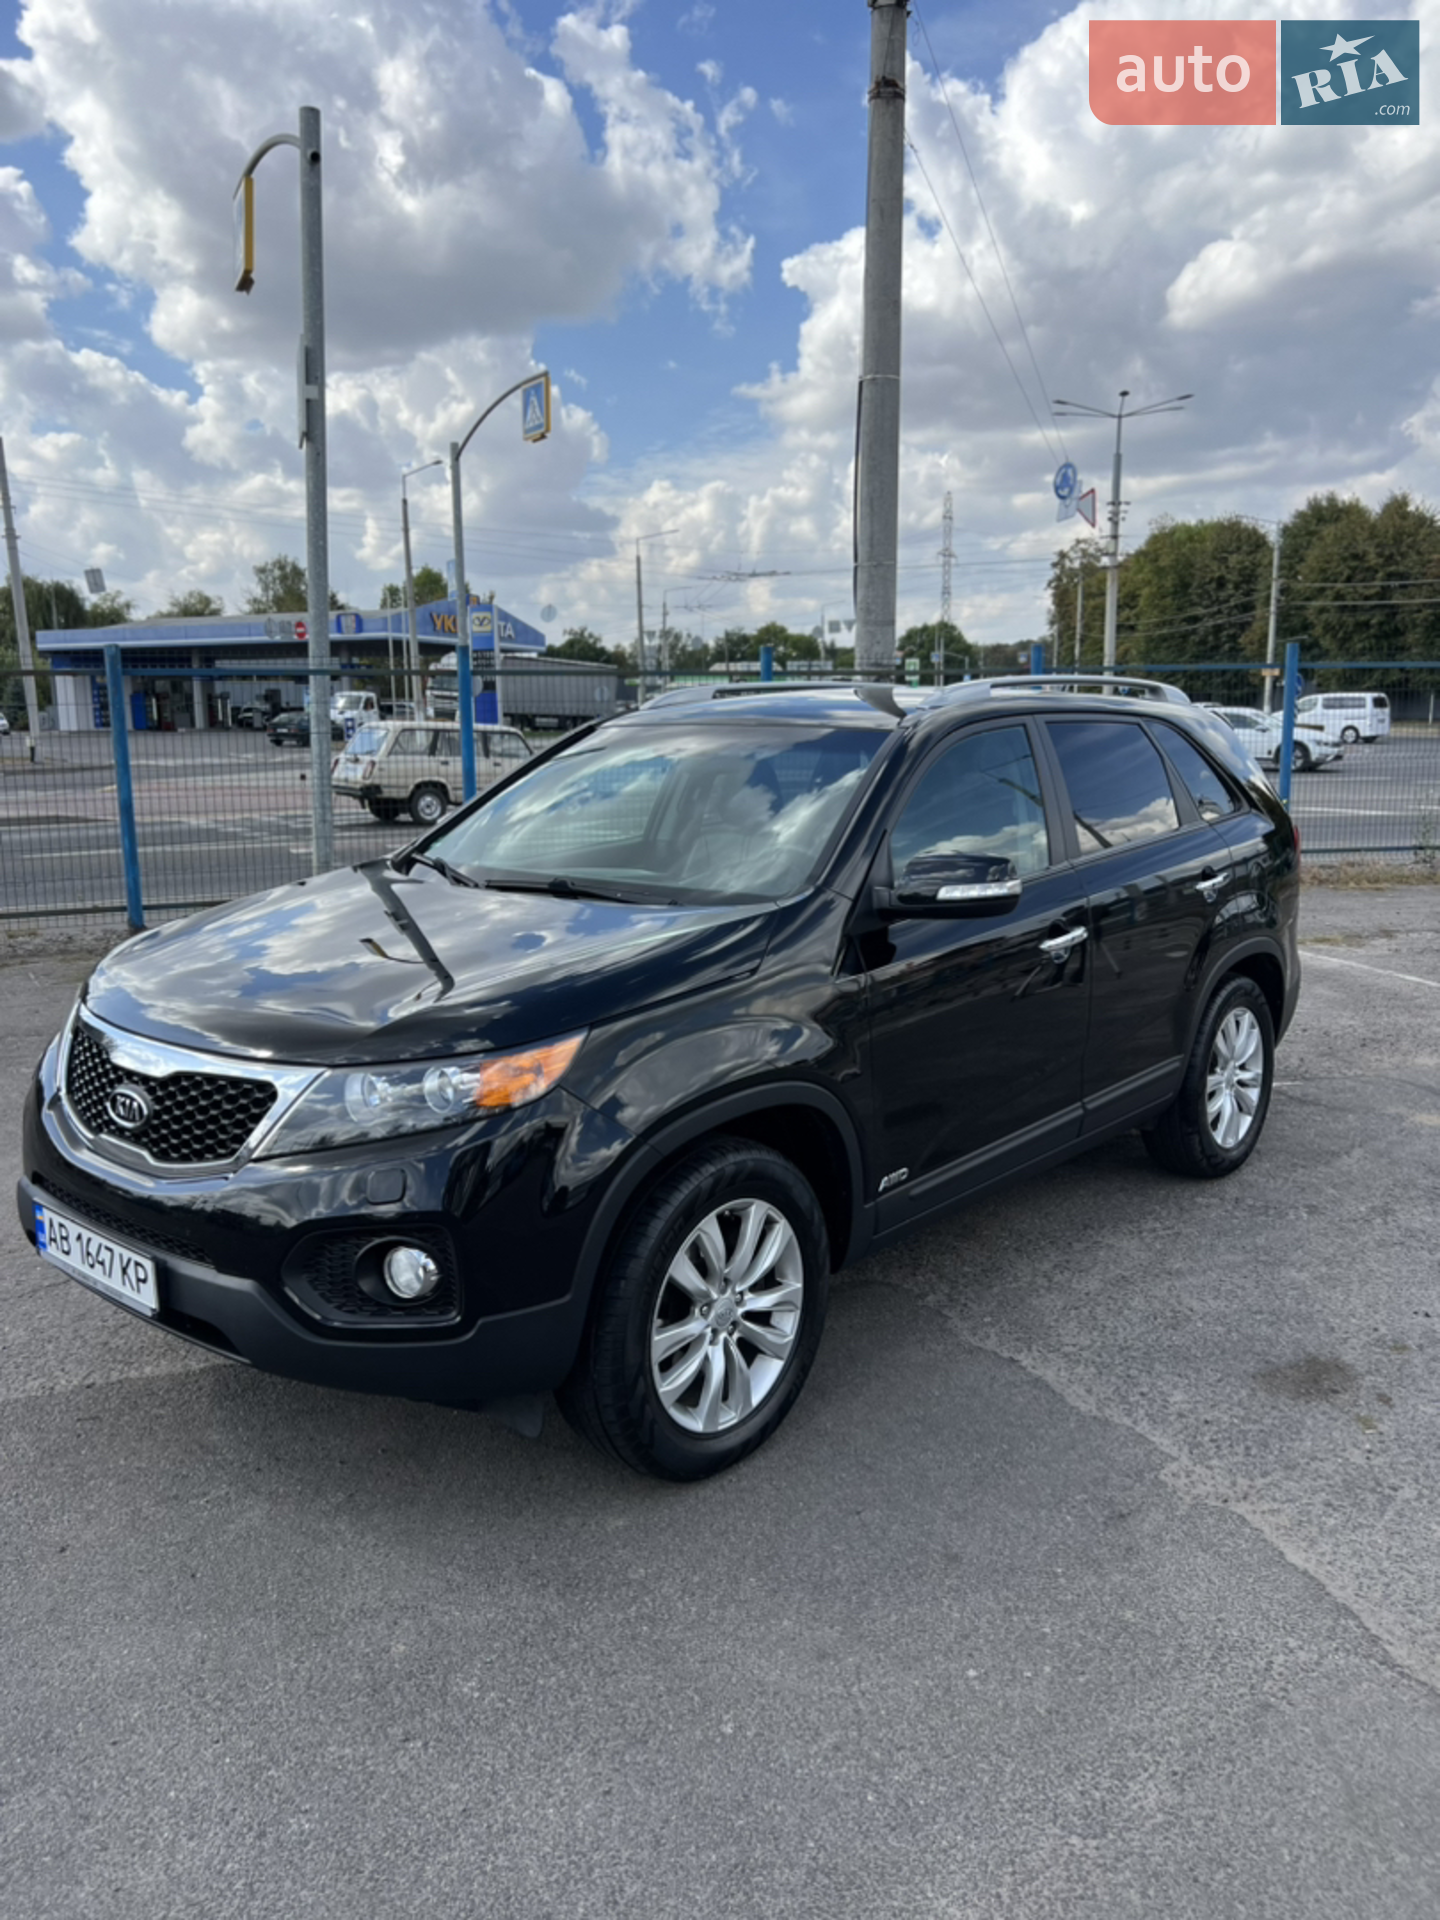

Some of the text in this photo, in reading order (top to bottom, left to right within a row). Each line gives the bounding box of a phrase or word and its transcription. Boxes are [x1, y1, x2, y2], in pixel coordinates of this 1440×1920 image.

[115, 1095, 140, 1121] KIA
[48, 1217, 72, 1256] AB
[75, 1232, 114, 1279] 1647
[119, 1252, 148, 1294] KP
